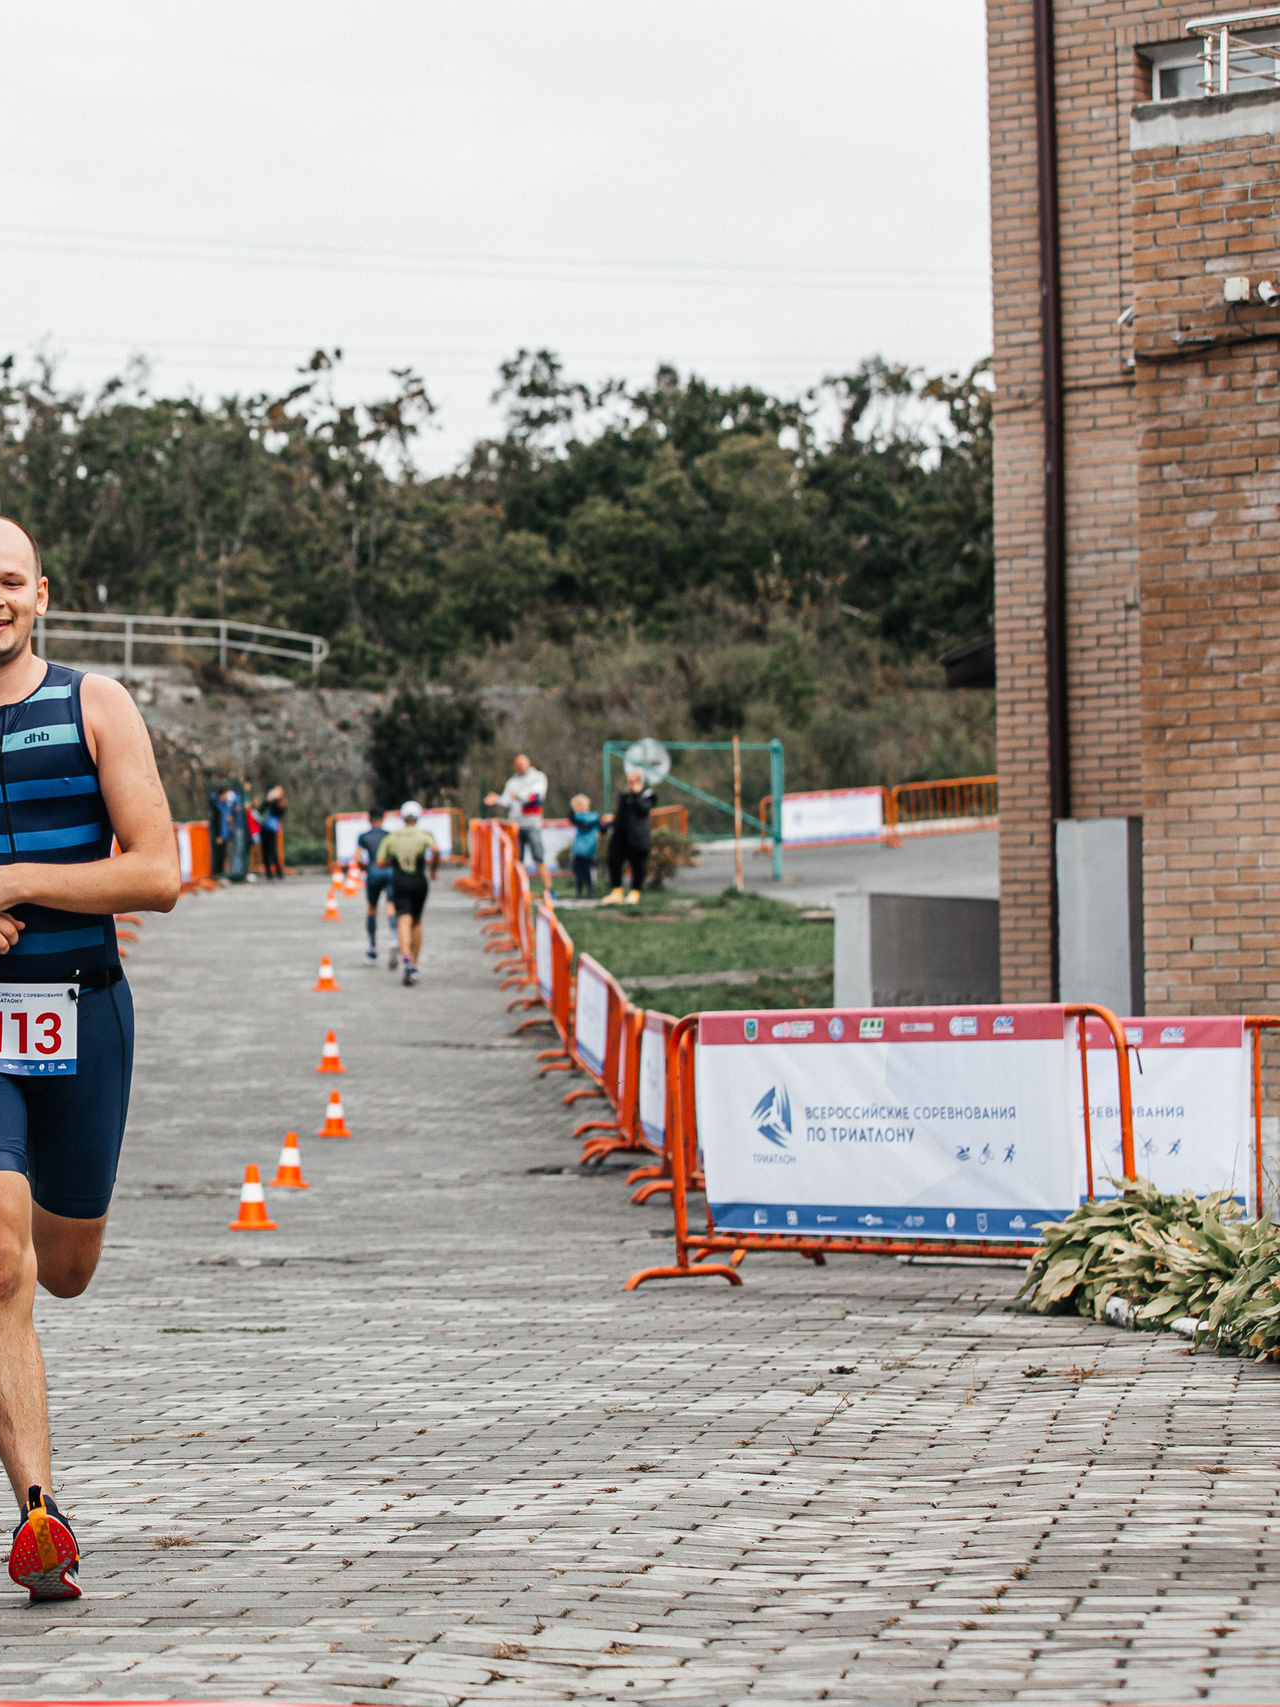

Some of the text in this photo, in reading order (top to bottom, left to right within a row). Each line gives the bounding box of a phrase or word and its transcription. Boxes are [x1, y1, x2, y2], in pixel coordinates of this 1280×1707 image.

[24, 731, 50, 744] dhb
[805, 1104, 1017, 1120] ВСЕРОССИЙСКИЕ СОРЕВНОВАНИЯ
[807, 1127, 915, 1143] ПО ТРИАТЛОНУ
